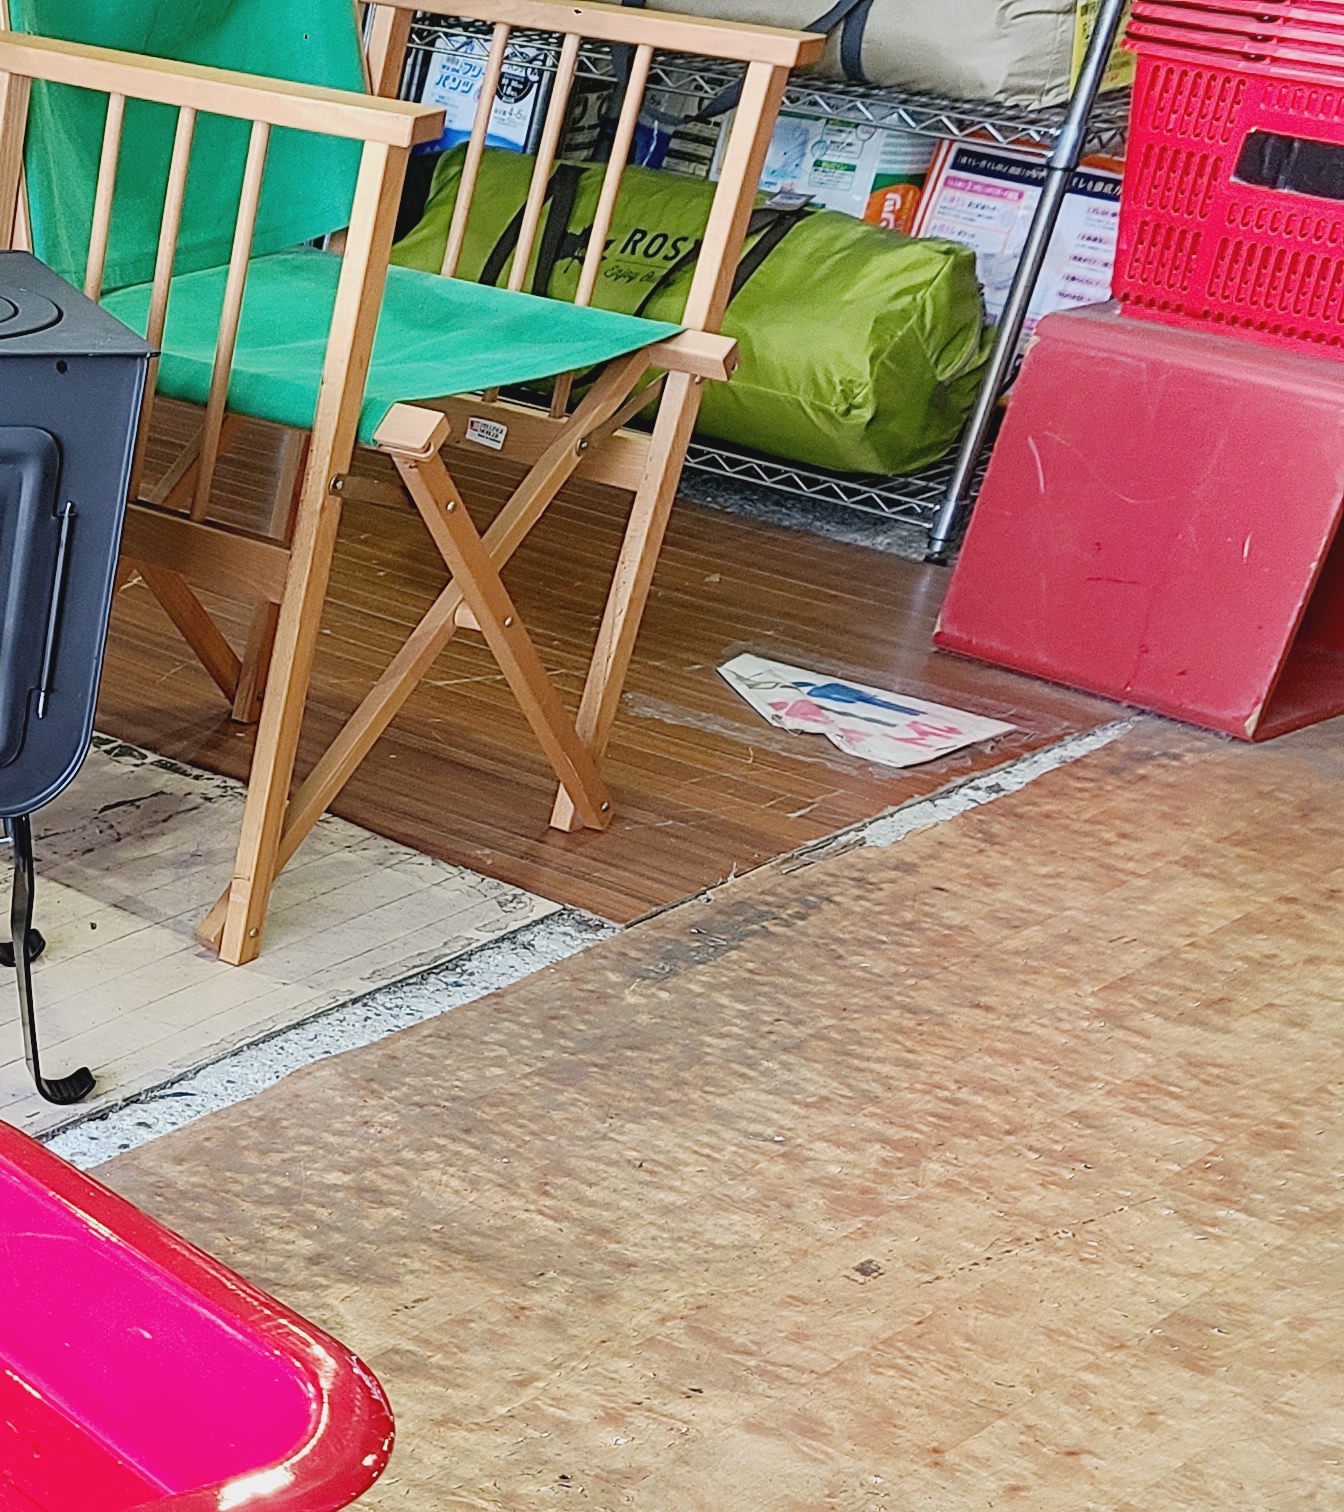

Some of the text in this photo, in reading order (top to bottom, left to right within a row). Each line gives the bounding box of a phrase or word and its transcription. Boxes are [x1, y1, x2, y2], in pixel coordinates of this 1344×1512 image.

[435, 73, 474, 94] パンツ
[620, 228, 696, 261] ROS
